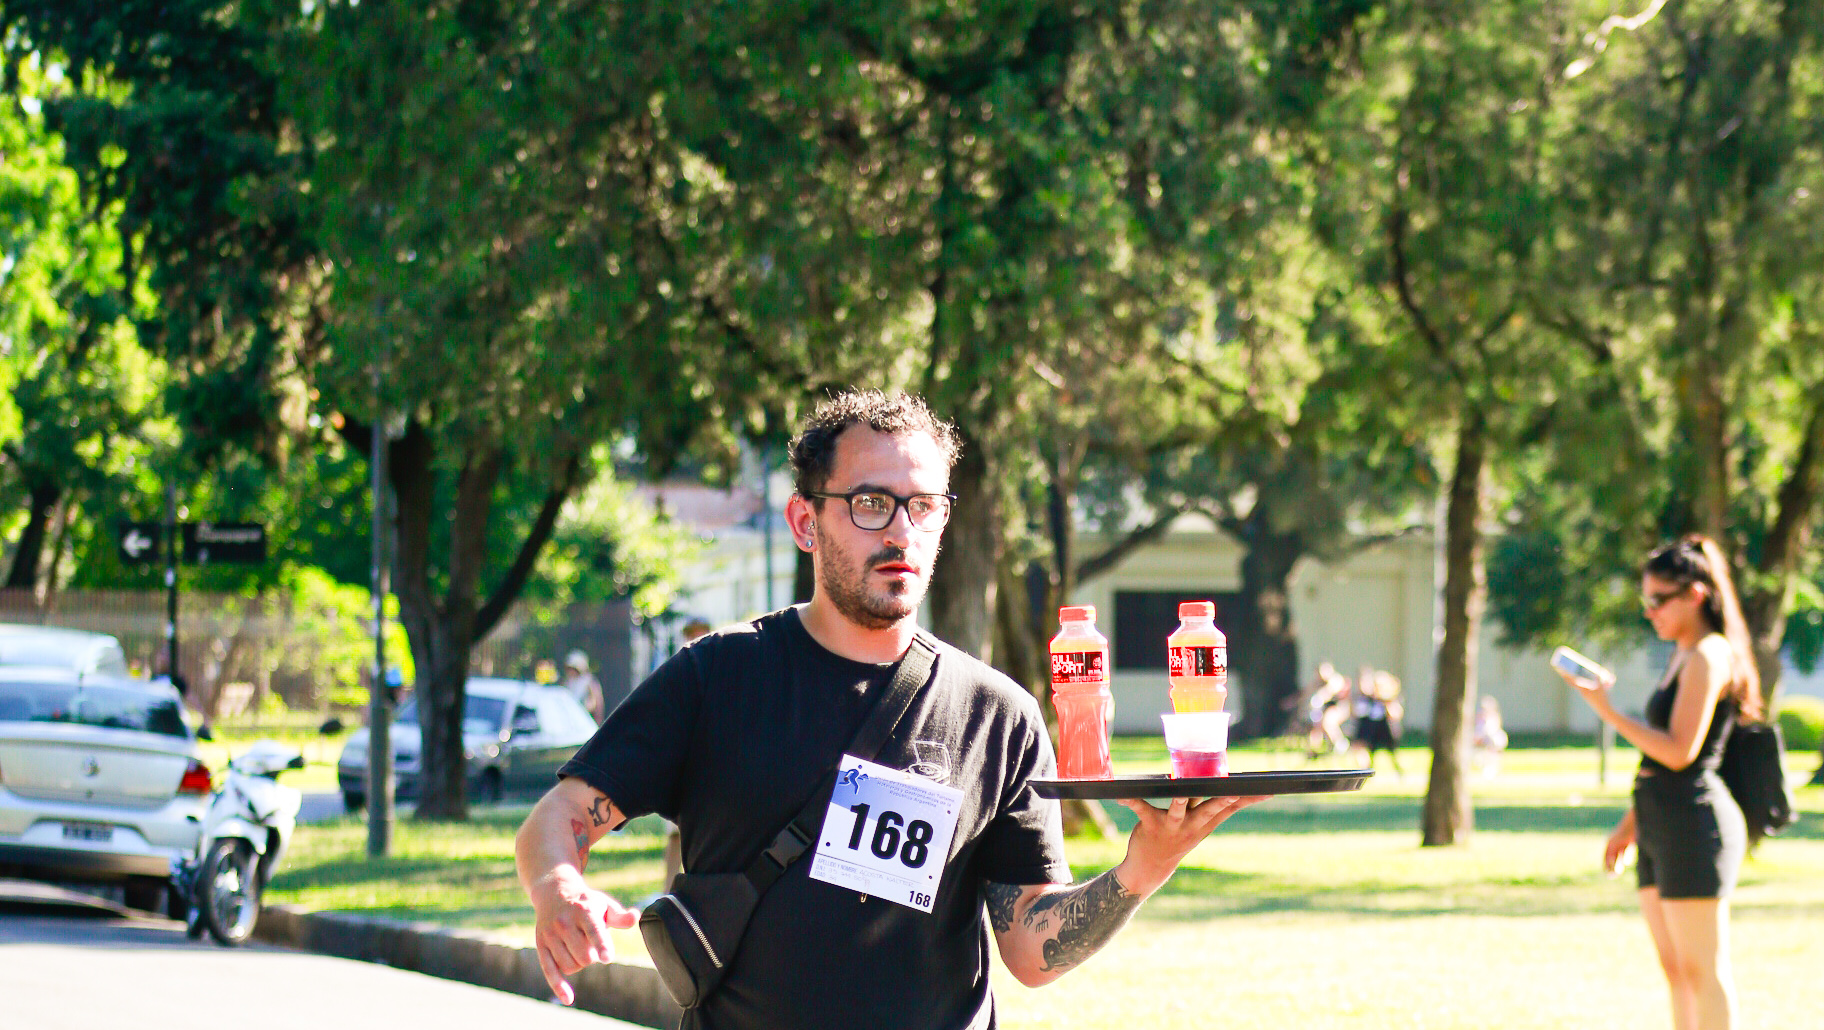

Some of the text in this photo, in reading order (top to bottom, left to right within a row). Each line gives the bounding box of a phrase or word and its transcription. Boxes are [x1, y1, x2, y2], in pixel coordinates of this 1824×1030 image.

[1052, 662, 1084, 674] SPORT
[913, 797, 937, 807] Argentina
[848, 803, 933, 869] 168
[909, 890, 931, 908] 168
